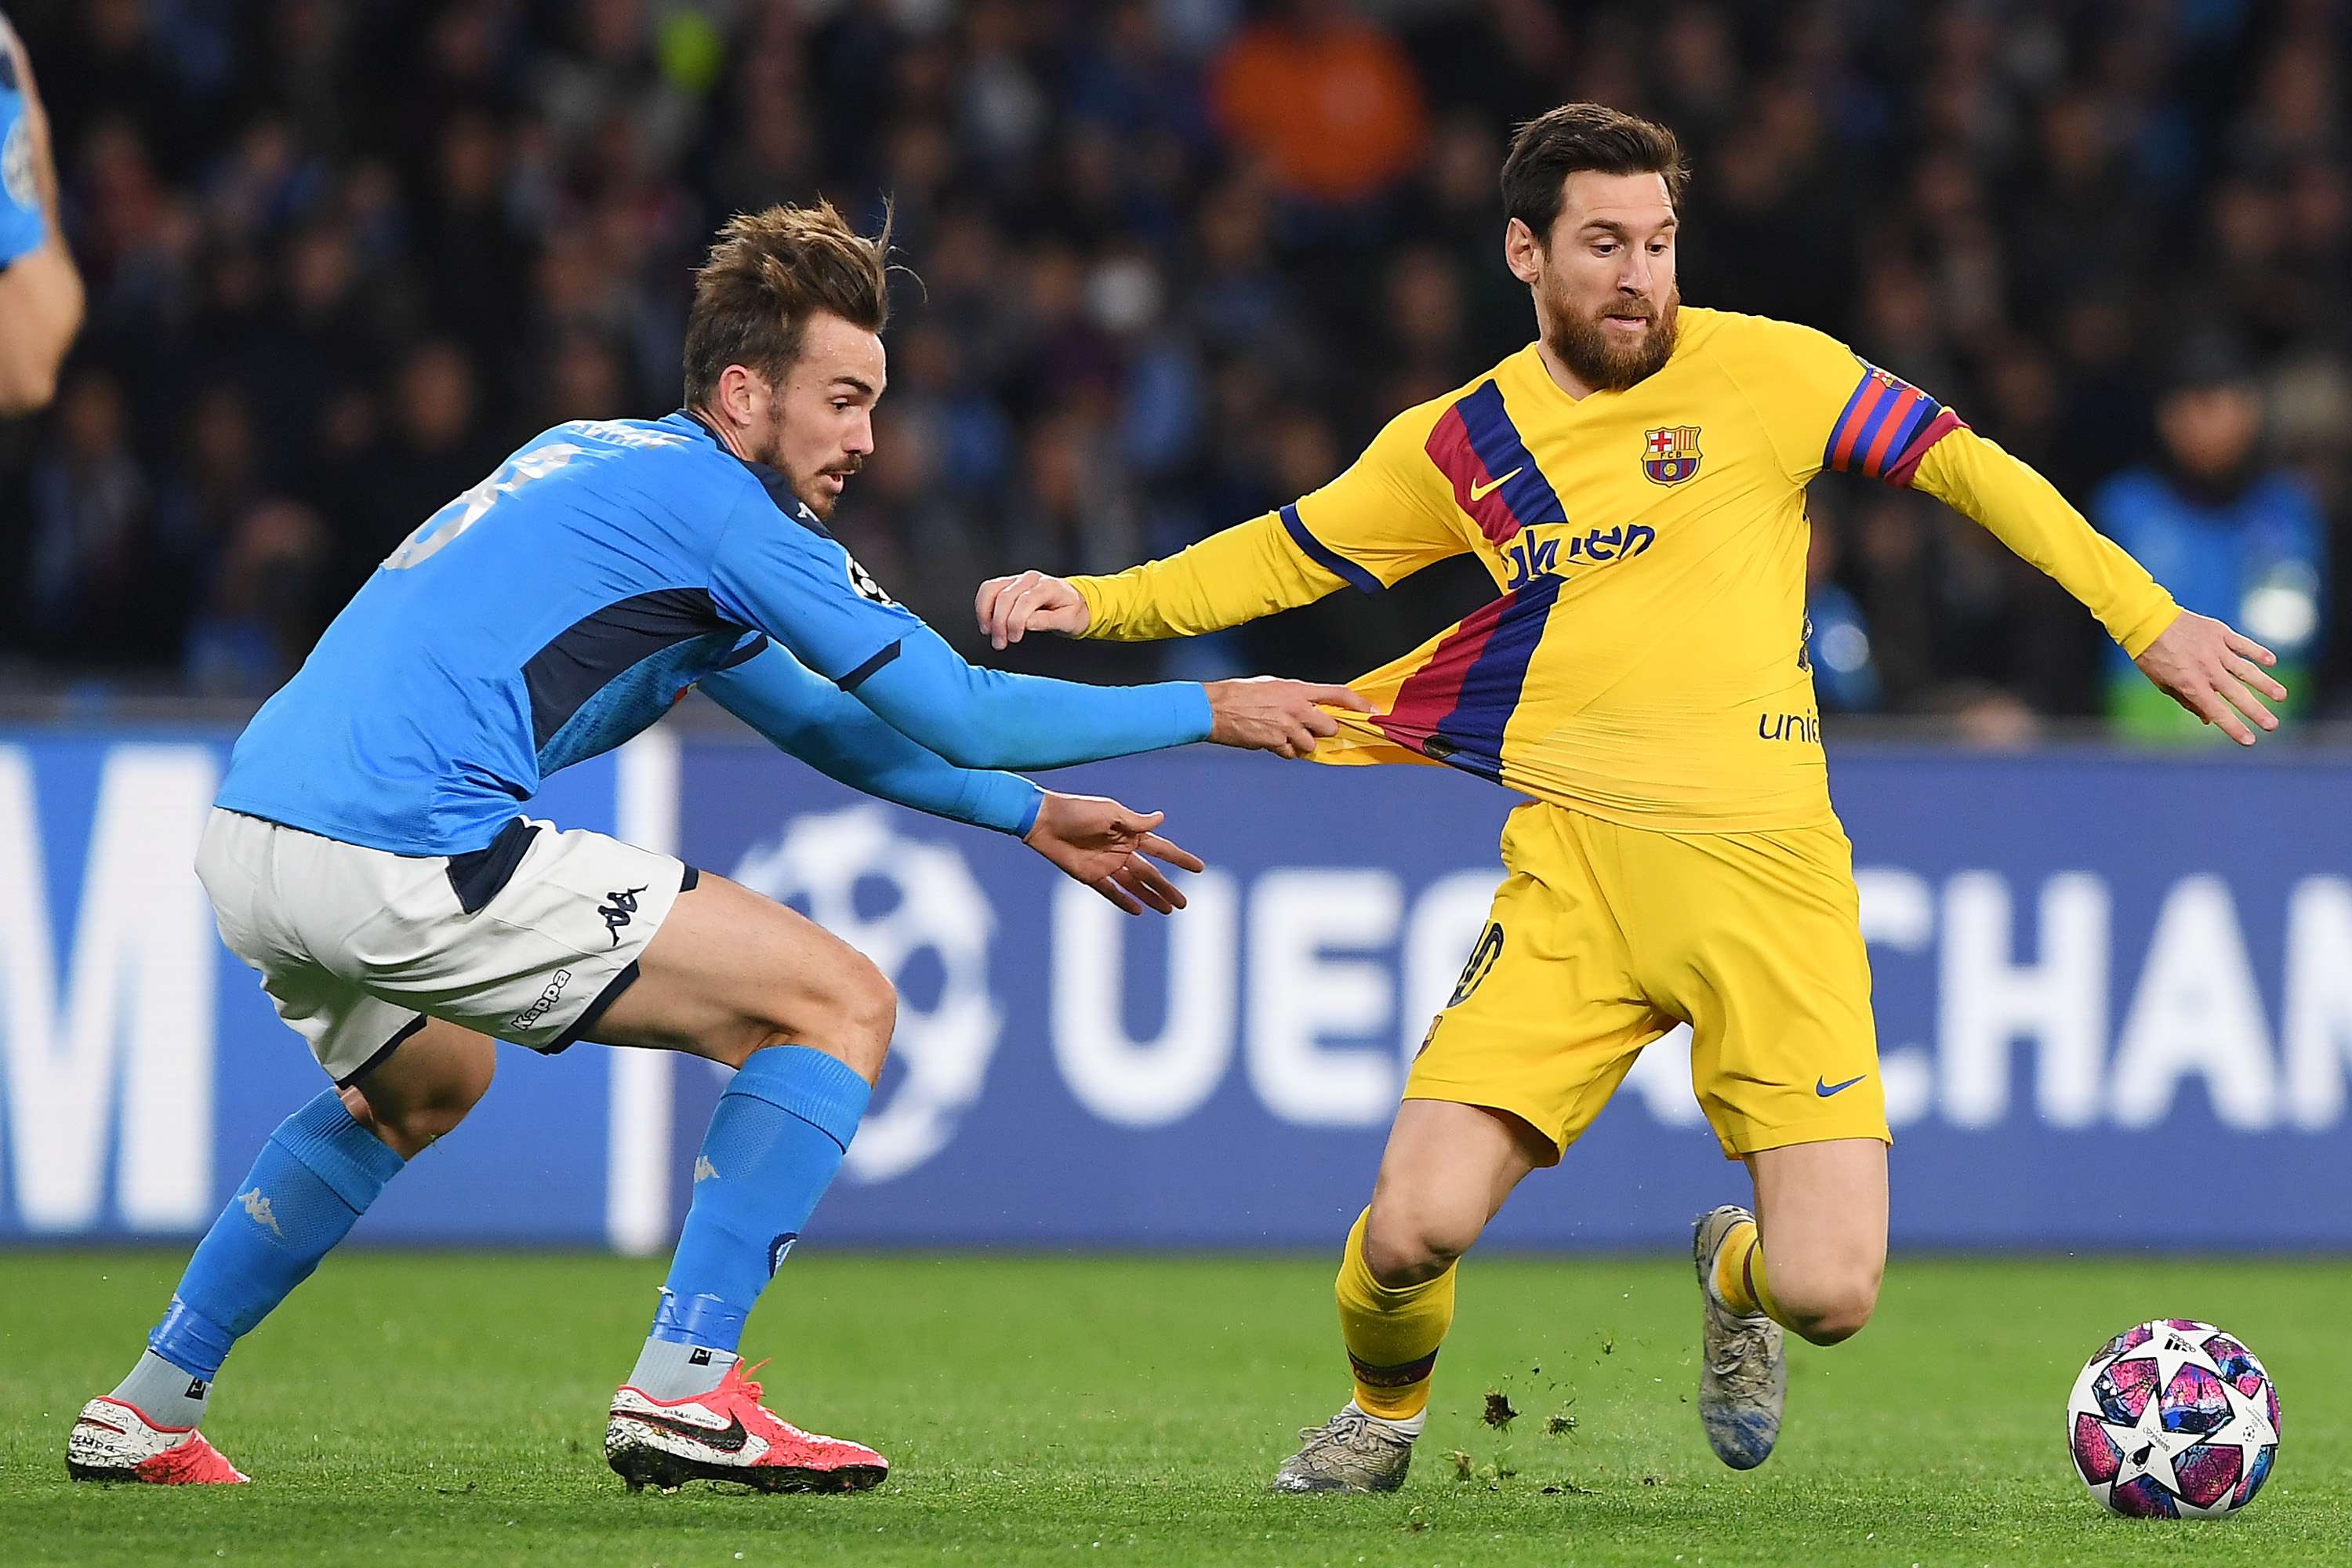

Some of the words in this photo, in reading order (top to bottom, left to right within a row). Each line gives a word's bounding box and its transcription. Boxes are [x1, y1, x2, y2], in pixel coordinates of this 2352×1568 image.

[1660, 451, 1682, 459] FCB
[511, 969, 572, 1031] Kappa
[1051, 866, 1693, 1127] UE
